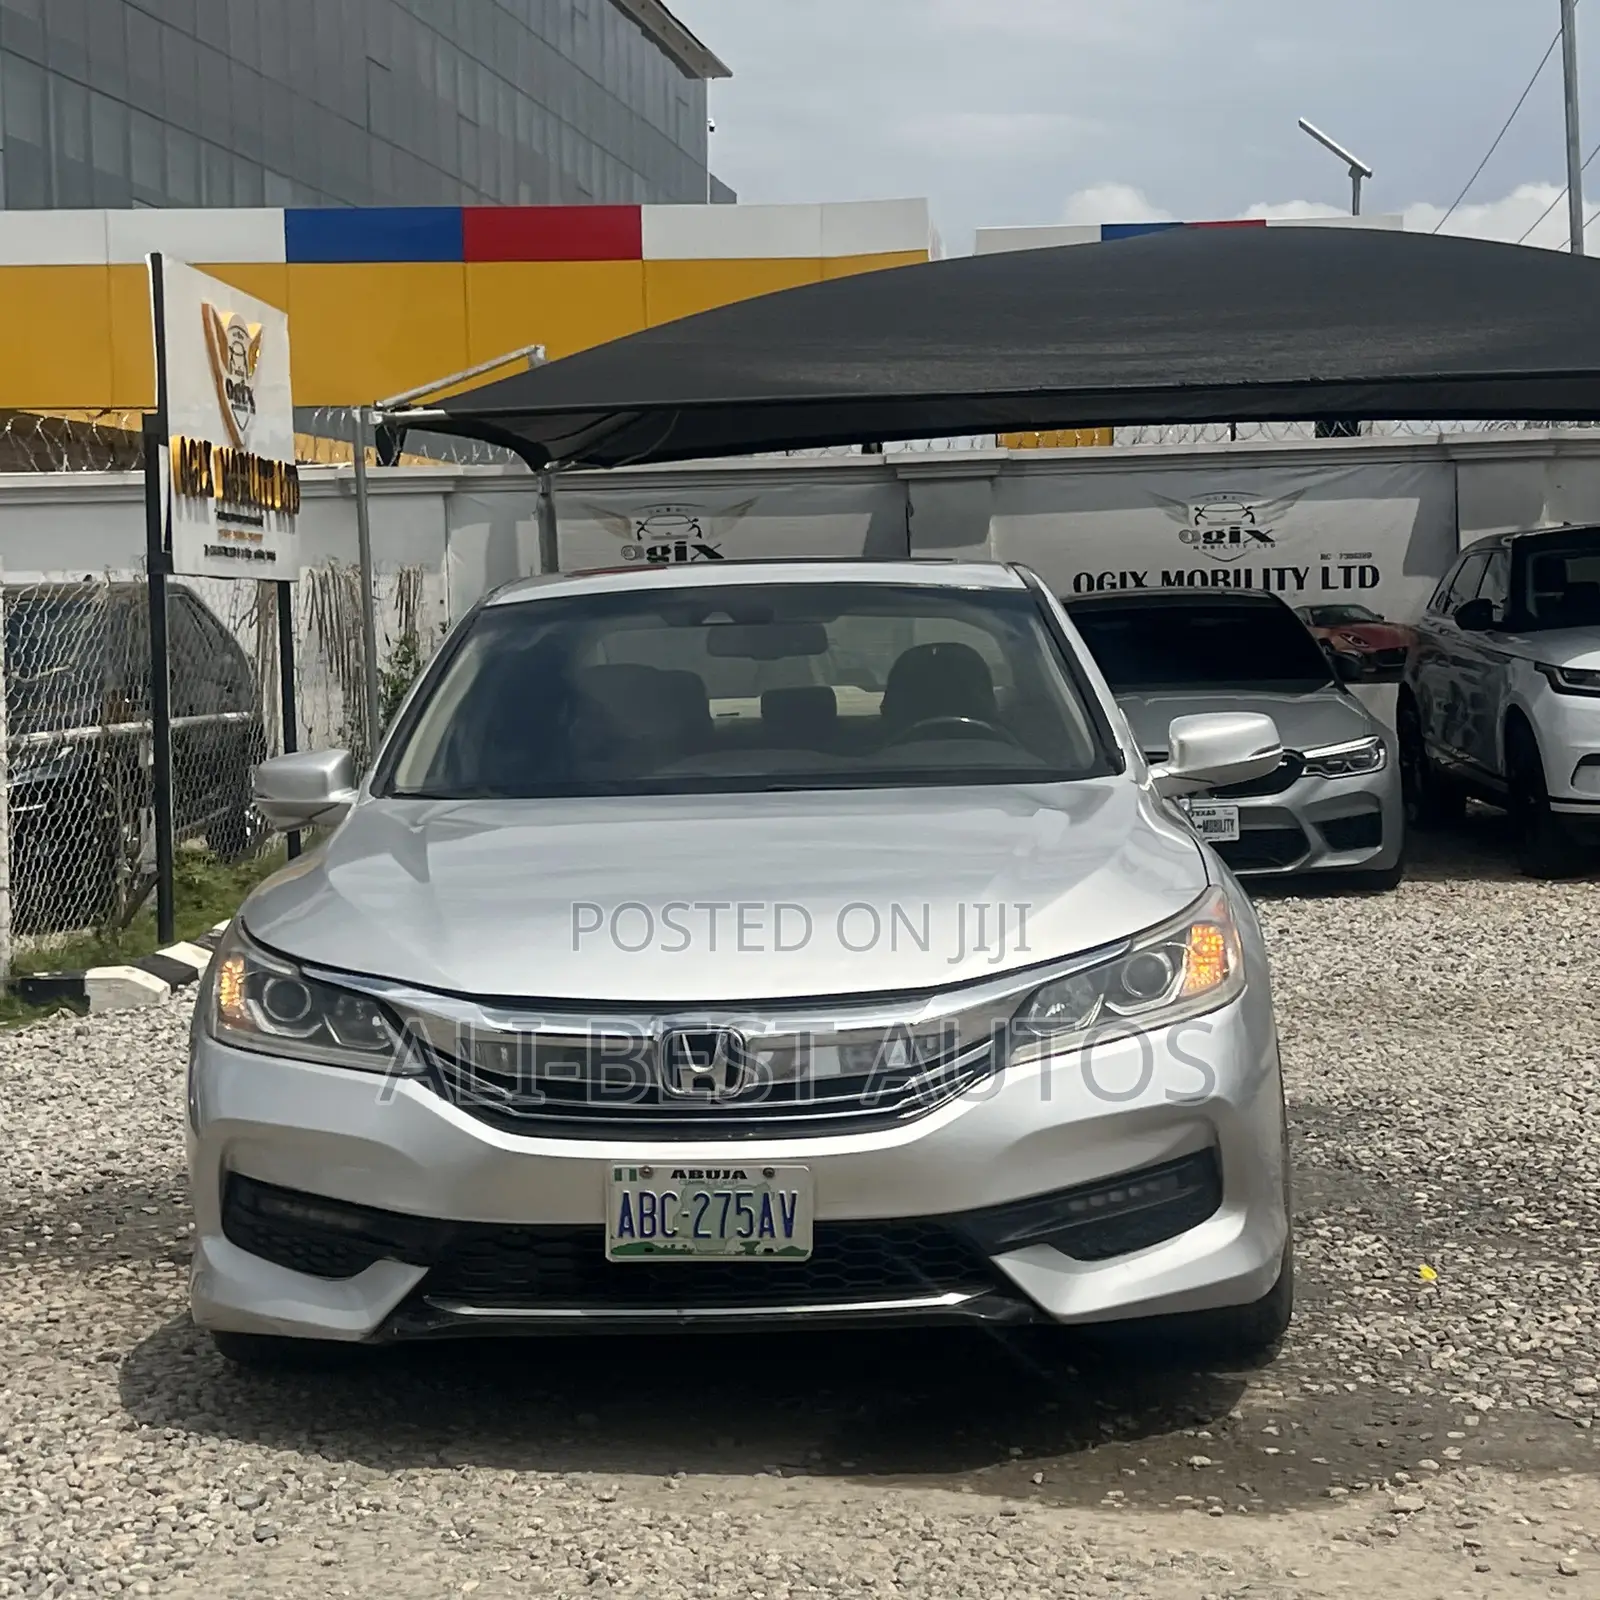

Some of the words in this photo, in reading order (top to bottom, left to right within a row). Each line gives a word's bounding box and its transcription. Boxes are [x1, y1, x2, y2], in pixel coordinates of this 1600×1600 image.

[1178, 526, 1275, 544] ogix
[620, 541, 724, 563] ogix
[1073, 570, 1148, 593] OGIX
[1161, 566, 1310, 591] MOBILITY
[1321, 565, 1380, 590] LTD
[670, 1169, 748, 1180] ABUJA
[617, 1190, 799, 1239] ABC-275AV
